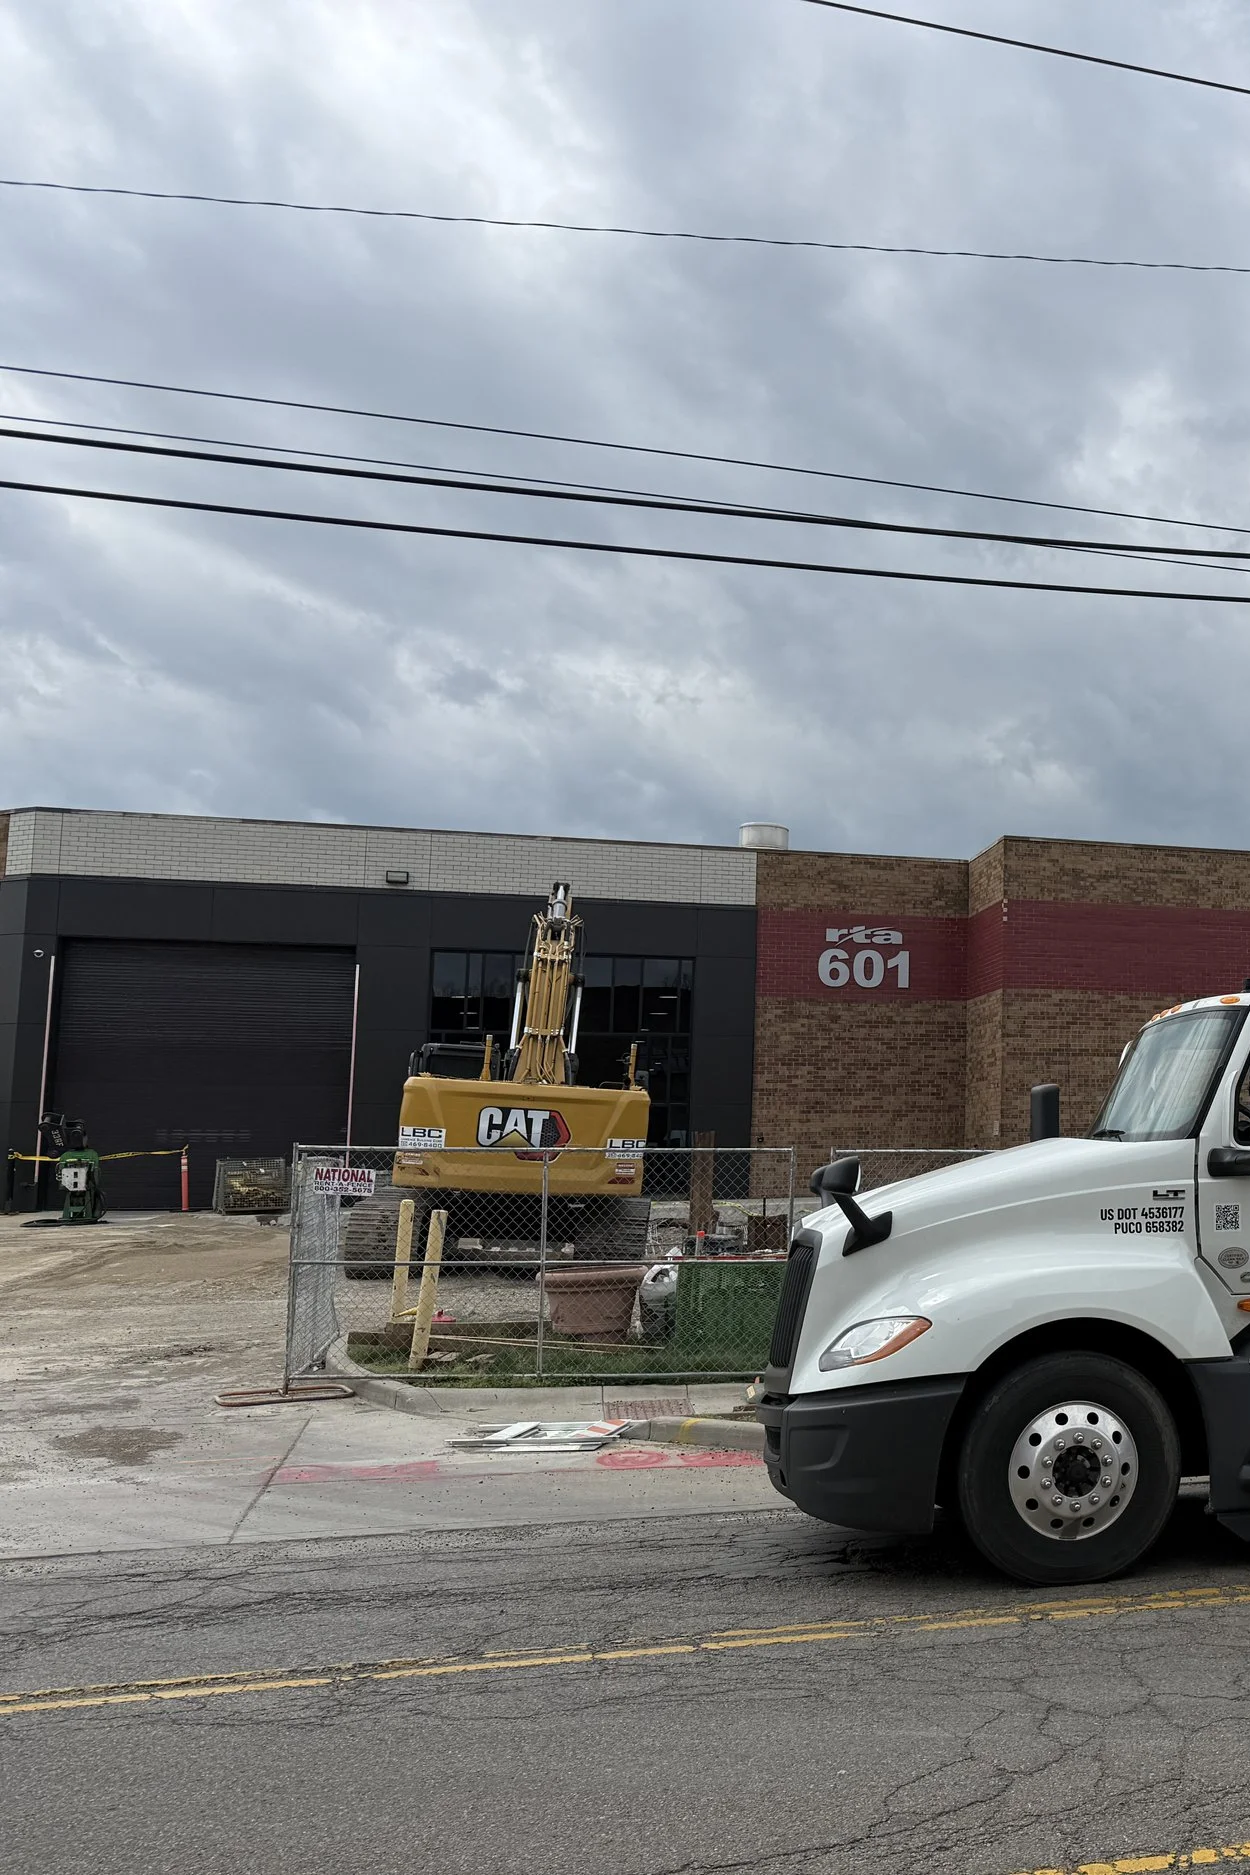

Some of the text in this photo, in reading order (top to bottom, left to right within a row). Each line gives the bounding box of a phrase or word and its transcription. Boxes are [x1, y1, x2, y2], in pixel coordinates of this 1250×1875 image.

[825, 926, 903, 945] rta
[818, 948, 910, 988] 601
[401, 1127, 443, 1139] LBC
[477, 1106, 550, 1148] CAT
[314, 1167, 373, 1183] NATIONAL
[314, 1180, 373, 1188] RENT-A-FENCE
[1100, 1206, 1185, 1220] US DOT 4536177
[1114, 1220, 1184, 1234] PUCO 658382
